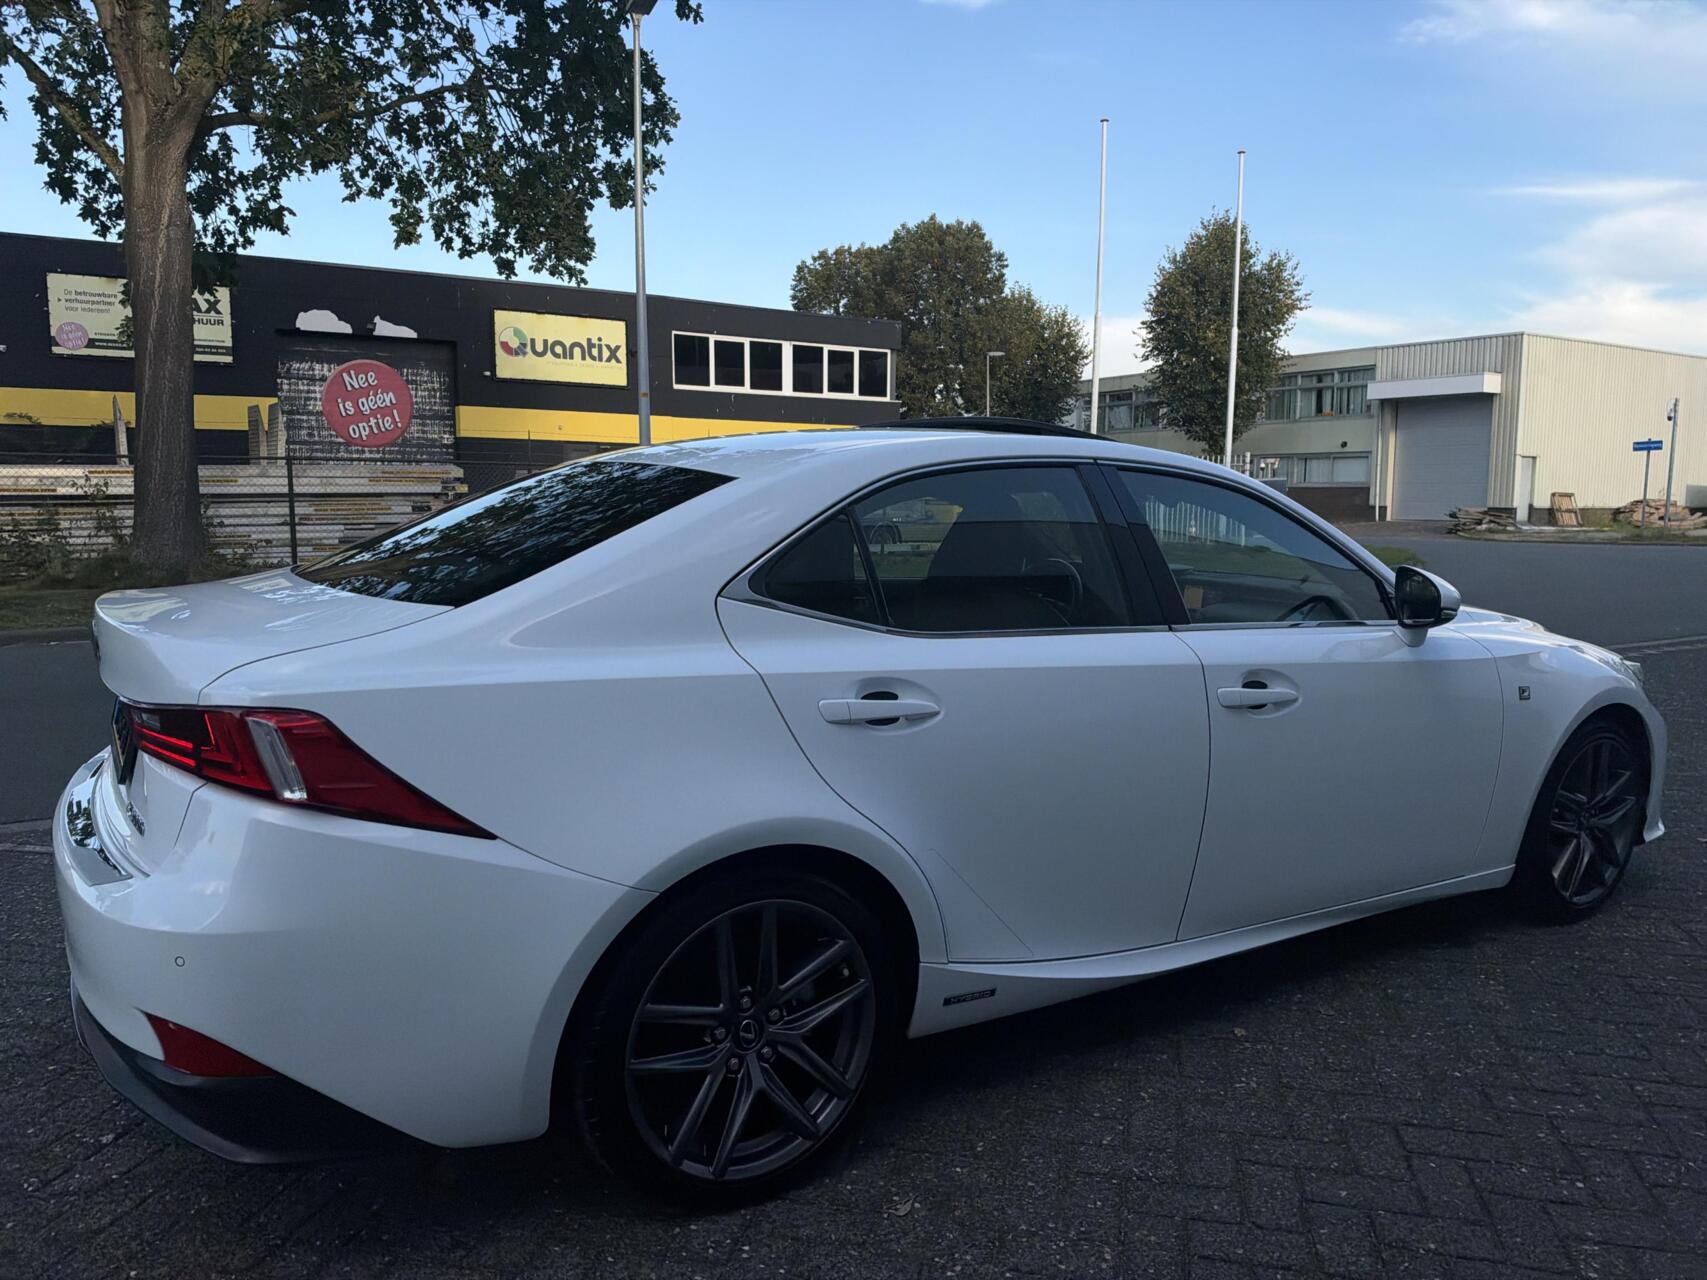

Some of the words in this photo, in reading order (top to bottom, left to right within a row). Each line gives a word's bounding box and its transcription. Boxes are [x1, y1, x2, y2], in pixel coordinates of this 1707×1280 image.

[64, 298, 115, 306] verhuurpartner
[74, 290, 118, 299] betrouwbare
[193, 317, 225, 327] HUUR
[499, 326, 622, 364] Quantix
[341, 369, 378, 392] Nee
[337, 398, 355, 417] is
[358, 388, 397, 415] géén
